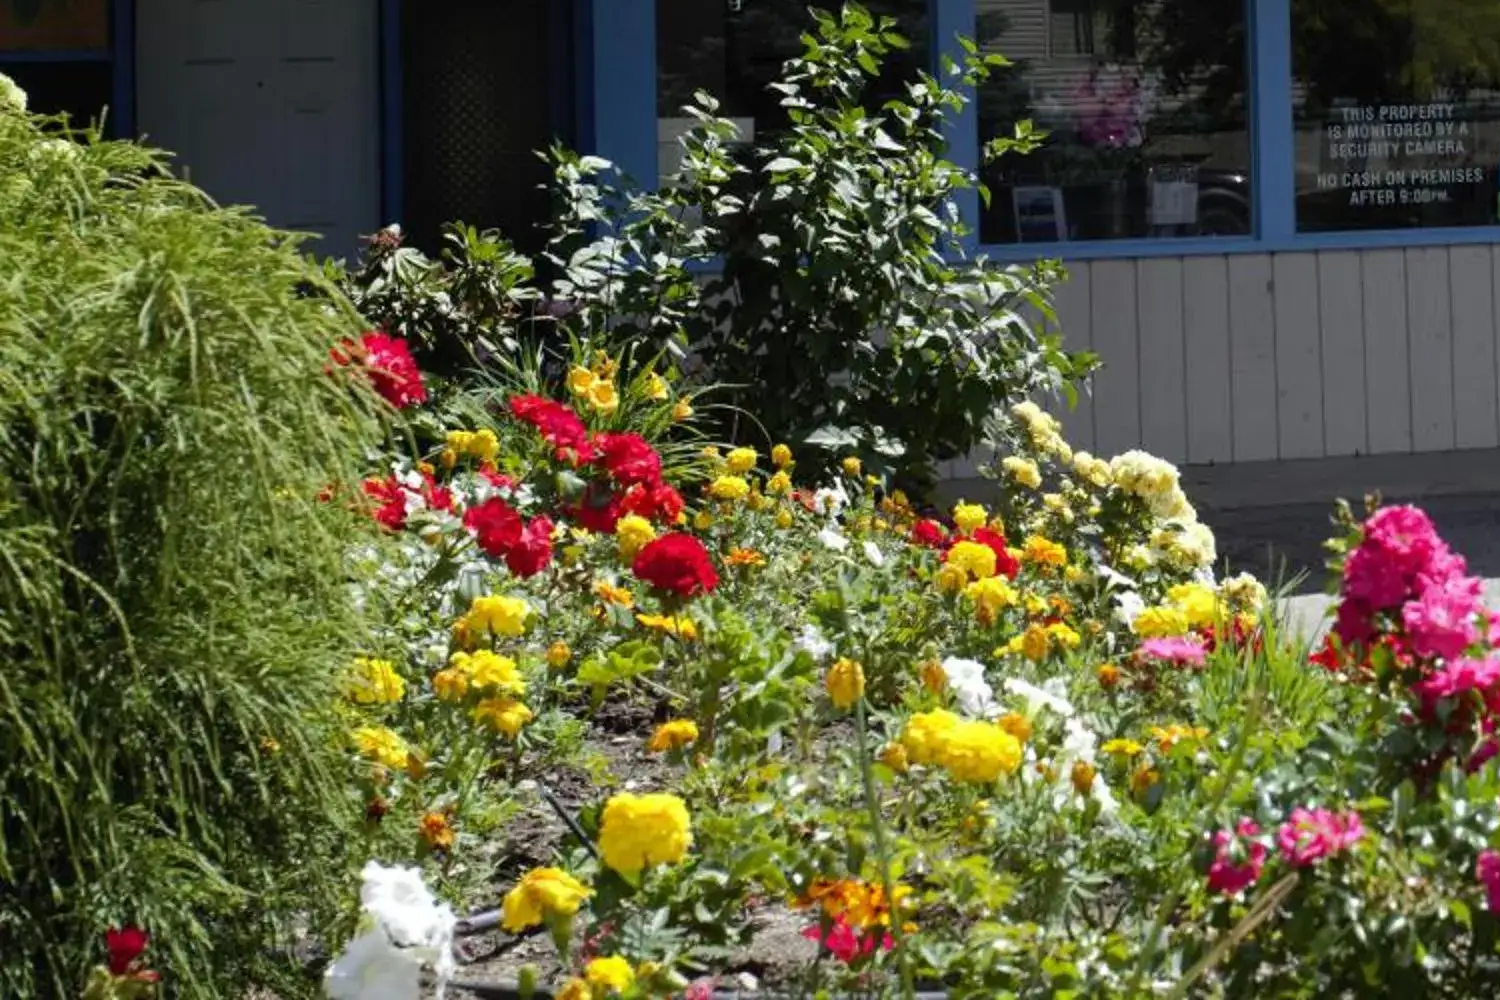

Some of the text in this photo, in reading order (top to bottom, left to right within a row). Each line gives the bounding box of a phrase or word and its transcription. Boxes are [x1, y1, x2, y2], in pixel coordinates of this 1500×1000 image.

[1342, 104, 1454, 122] THIS PROPERTY
[1328, 121, 1469, 139] IS MONITORED BY A
[1330, 139, 1465, 159] SECURITY CAMERA
[1317, 167, 1484, 188] NO CASH ON PREMISES
[1349, 189, 1396, 206] AFTER
